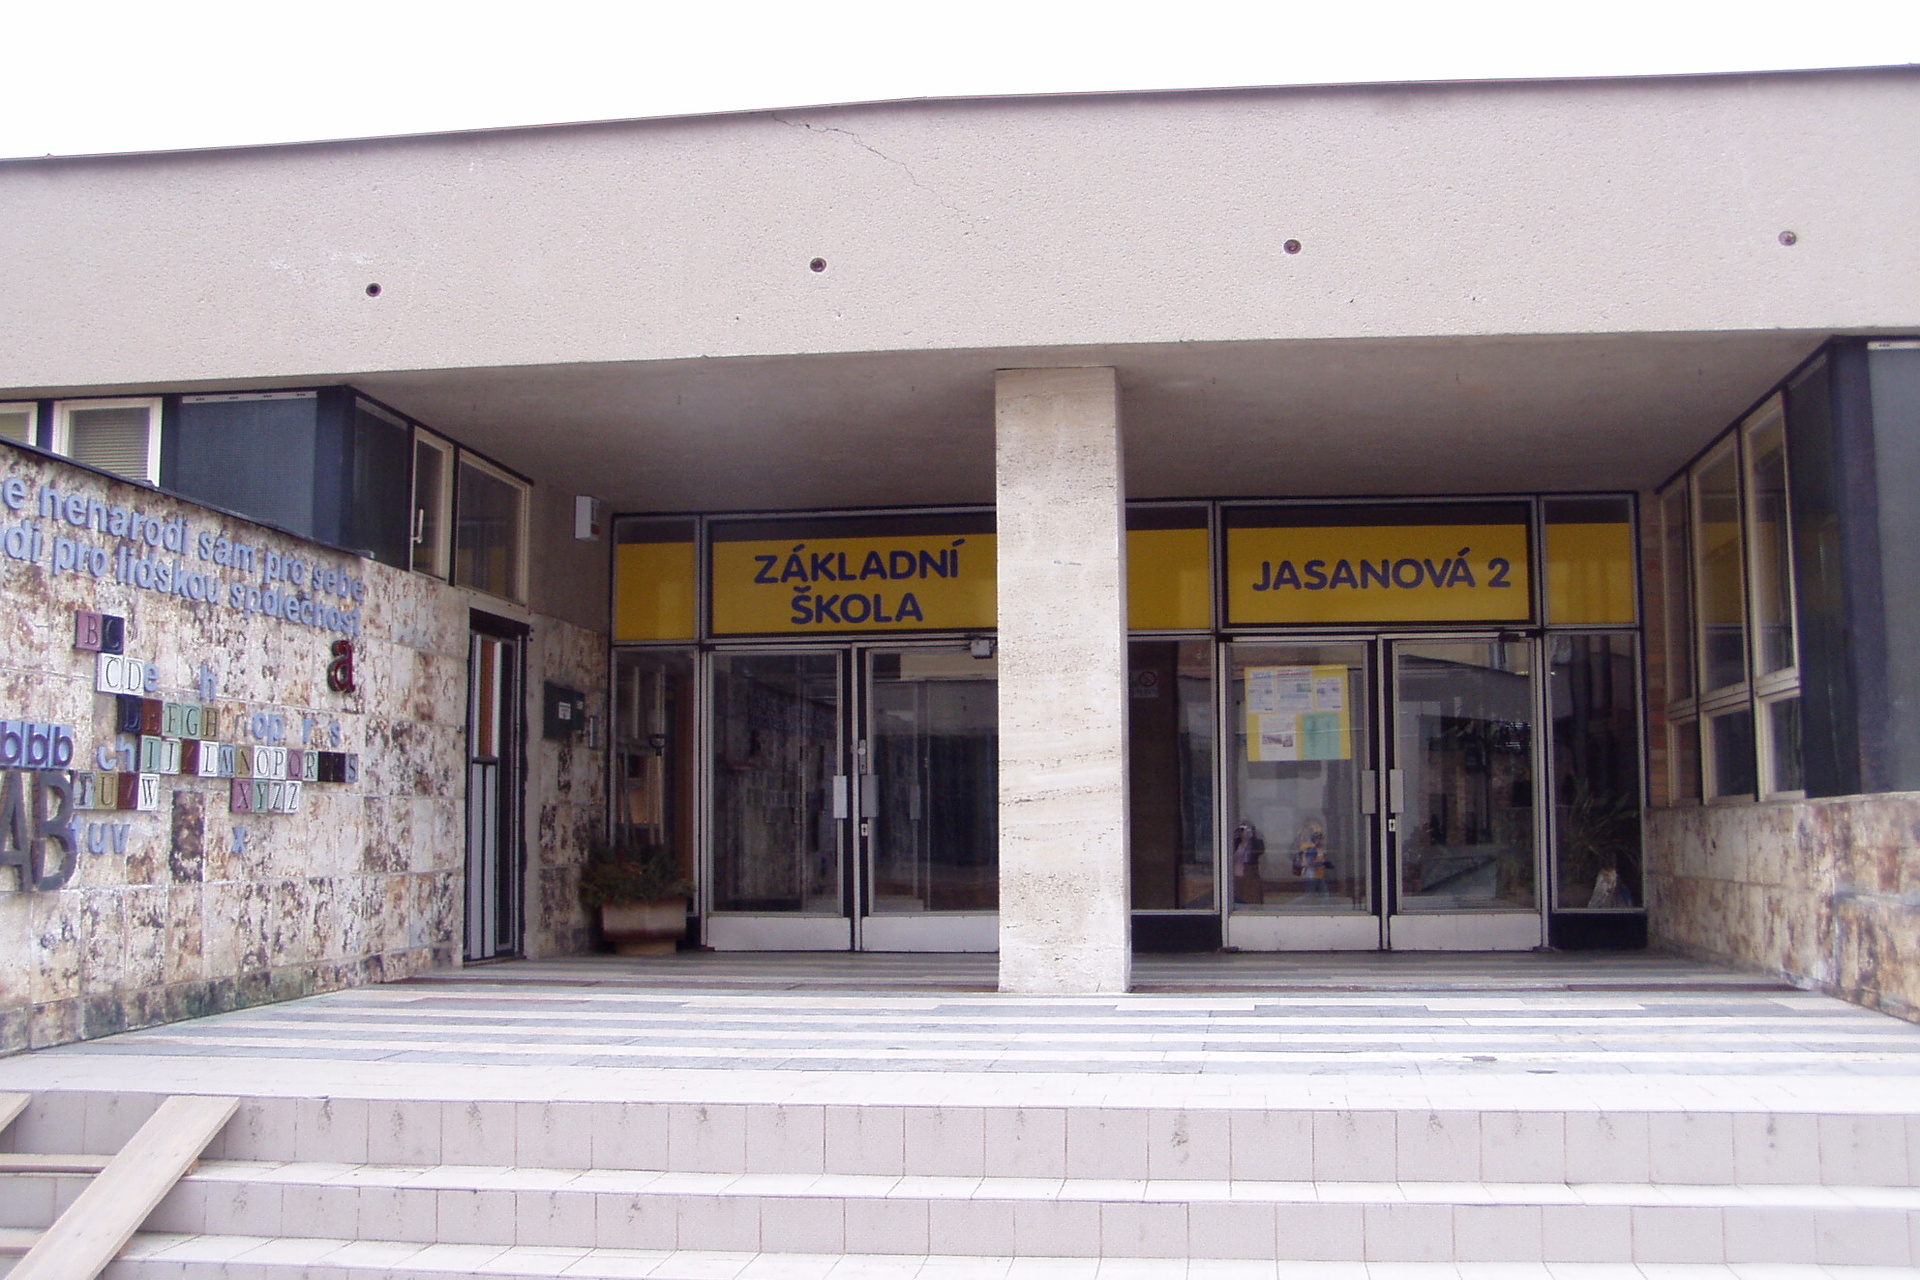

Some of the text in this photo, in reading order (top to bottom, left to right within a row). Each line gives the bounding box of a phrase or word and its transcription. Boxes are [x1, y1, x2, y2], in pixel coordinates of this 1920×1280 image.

[0, 519, 361, 637] di pro lidskou společnost
[198, 529, 257, 573] sám
[263, 551, 304, 586] pro
[311, 564, 365, 603] sebe
[754, 538, 965, 584] ZÁKLADNÍ
[1252, 546, 1511, 592] JASANOVÁ 2
[791, 585, 923, 625] ŠKOLA
[328, 639, 356, 694] a
